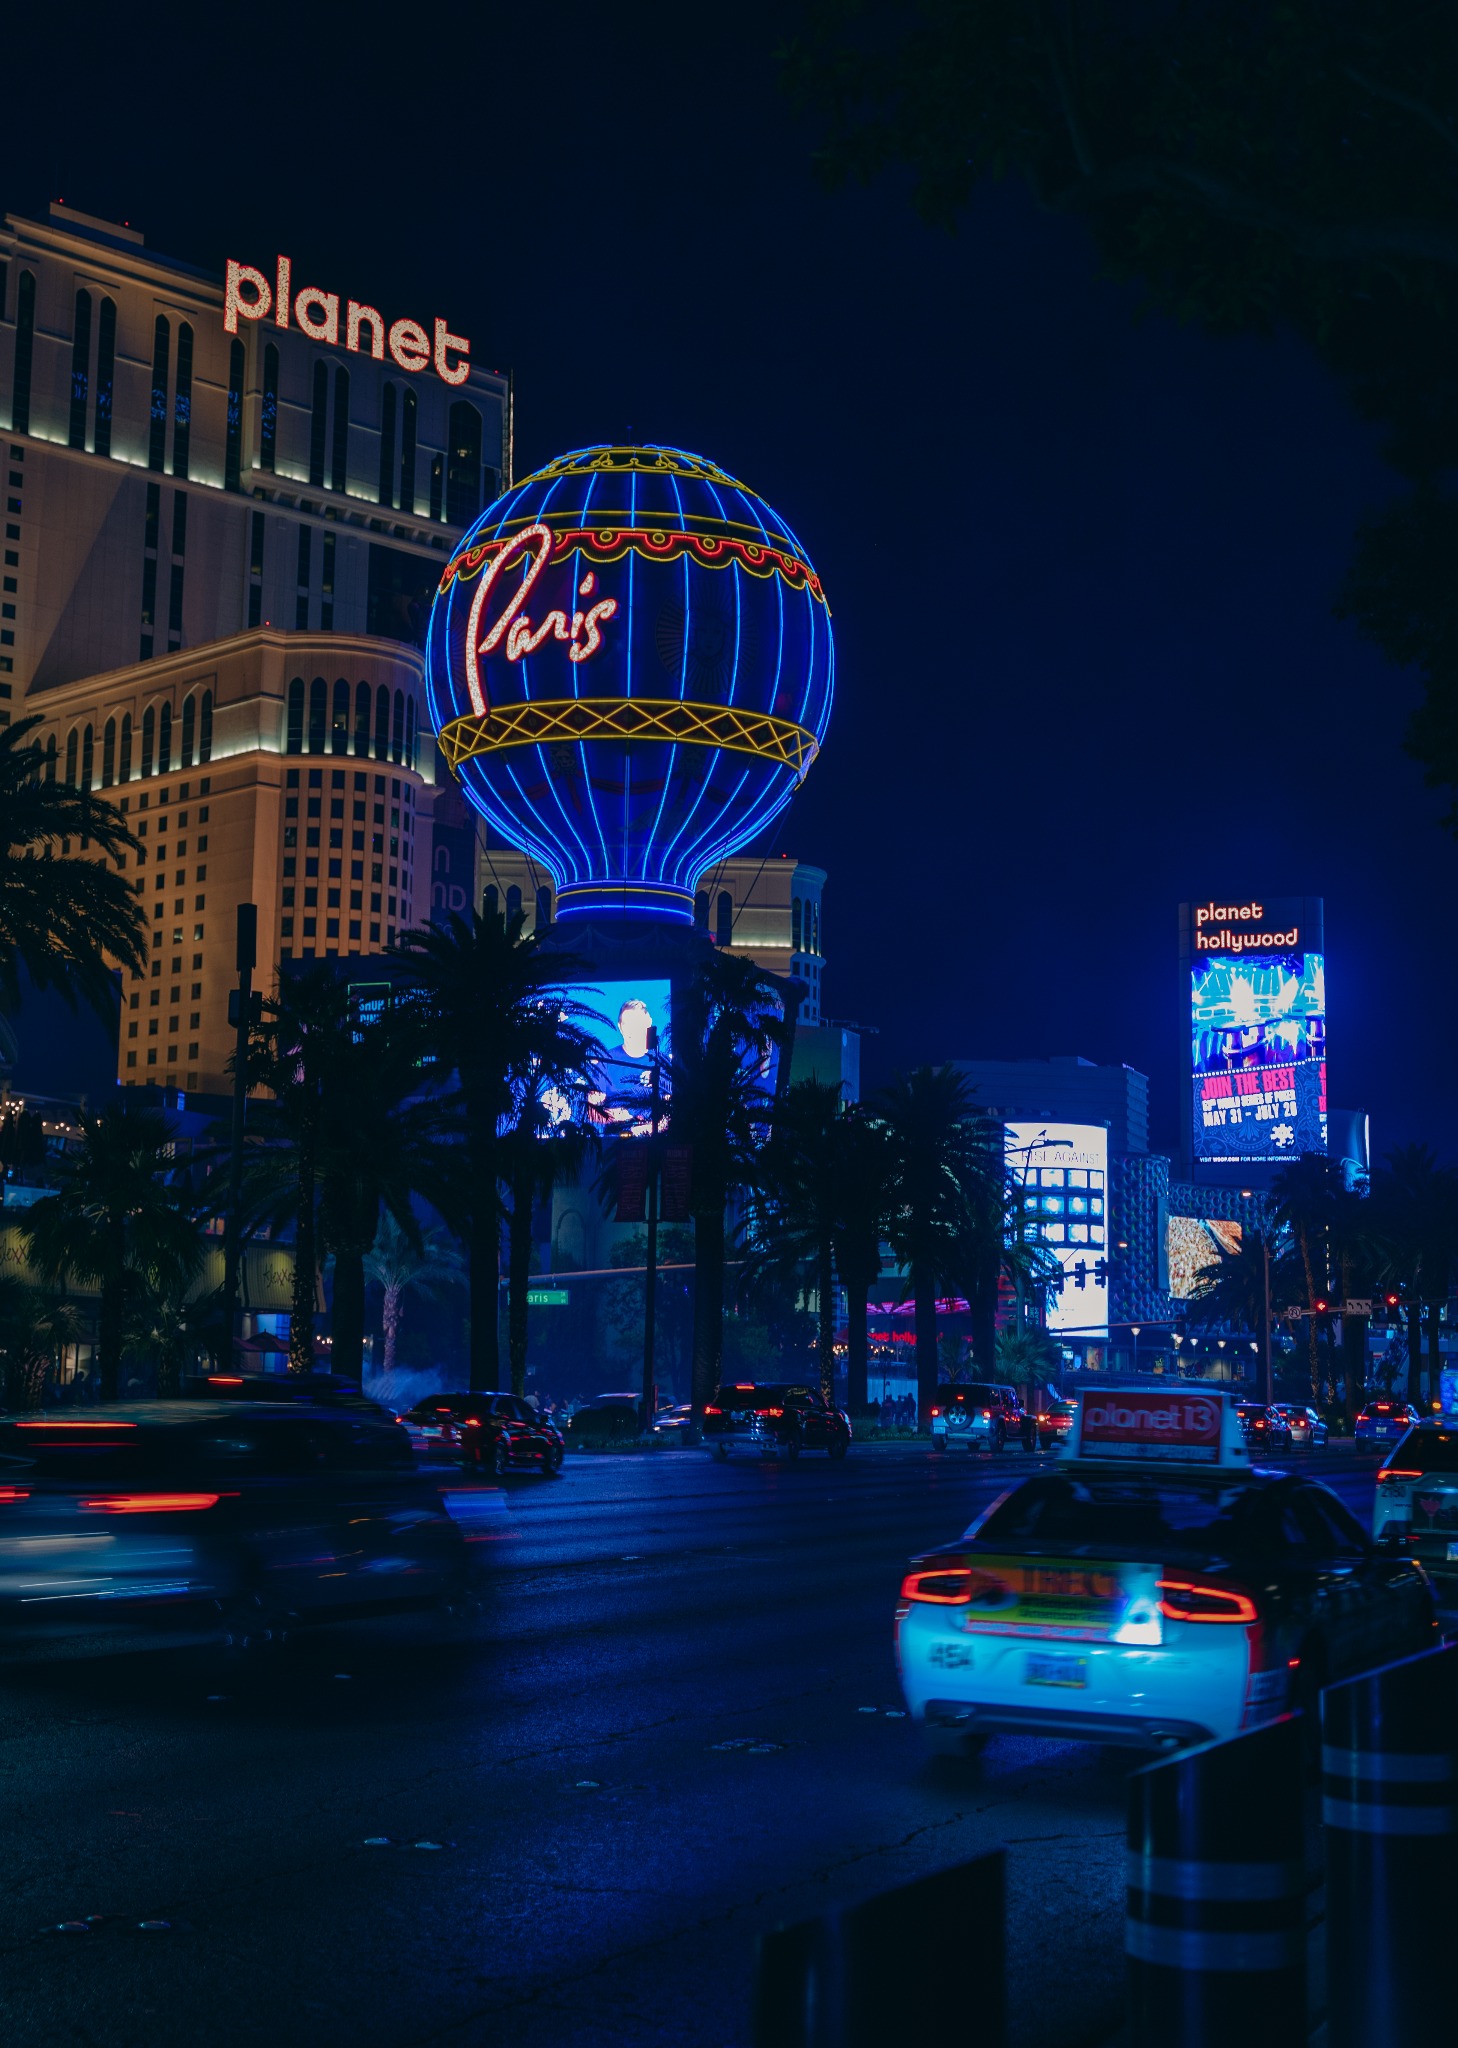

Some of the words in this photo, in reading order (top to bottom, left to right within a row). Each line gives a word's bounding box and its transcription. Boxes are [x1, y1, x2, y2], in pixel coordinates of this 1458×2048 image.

[224, 254, 470, 386] planet
[465, 523, 616, 718] Paris
[1196, 902, 1263, 927] planet
[1196, 927, 1299, 952] hollywood
[1201, 1076, 1232, 1100] JOIN
[1234, 1072, 1260, 1095] THE
[1262, 1067, 1295, 1092] BEST
[1203, 1110, 1226, 1127] MAY
[1230, 1108, 1242, 1124] 31
[1255, 1103, 1279, 1120] JULY
[1054, 1151, 1100, 1165] AGAINST
[1084, 1402, 1182, 1433] planet
[1183, 1404, 1213, 1431] 13
